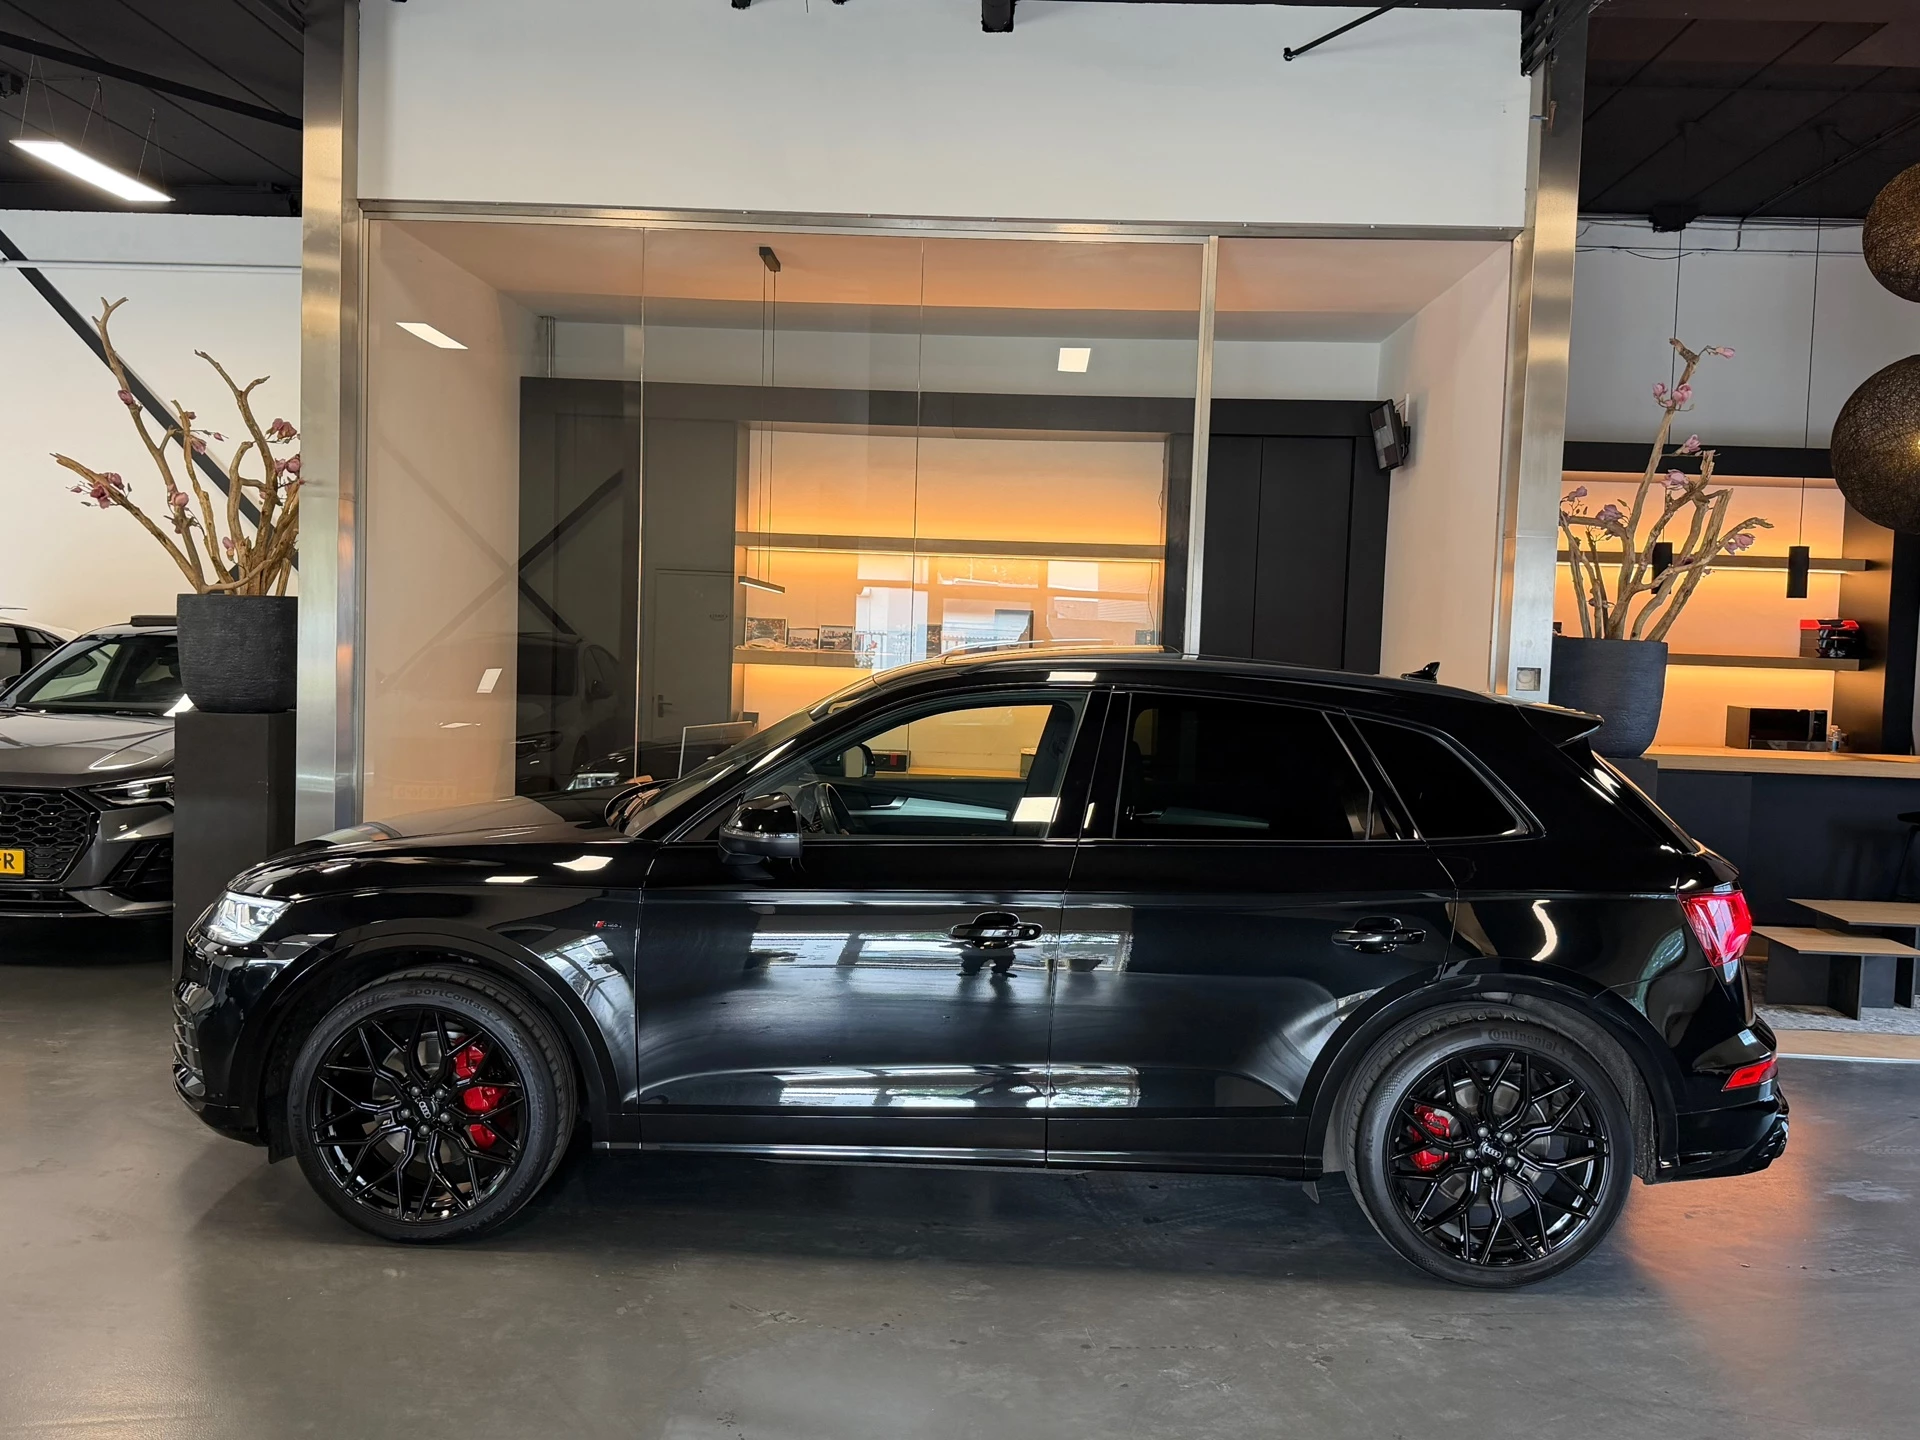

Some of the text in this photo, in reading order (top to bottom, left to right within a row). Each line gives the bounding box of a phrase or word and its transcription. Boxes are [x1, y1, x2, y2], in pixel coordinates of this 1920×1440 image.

[0, 853, 15, 870] R
[406, 988, 493, 1016] SportContact
[1488, 1028, 1558, 1052] Continental
